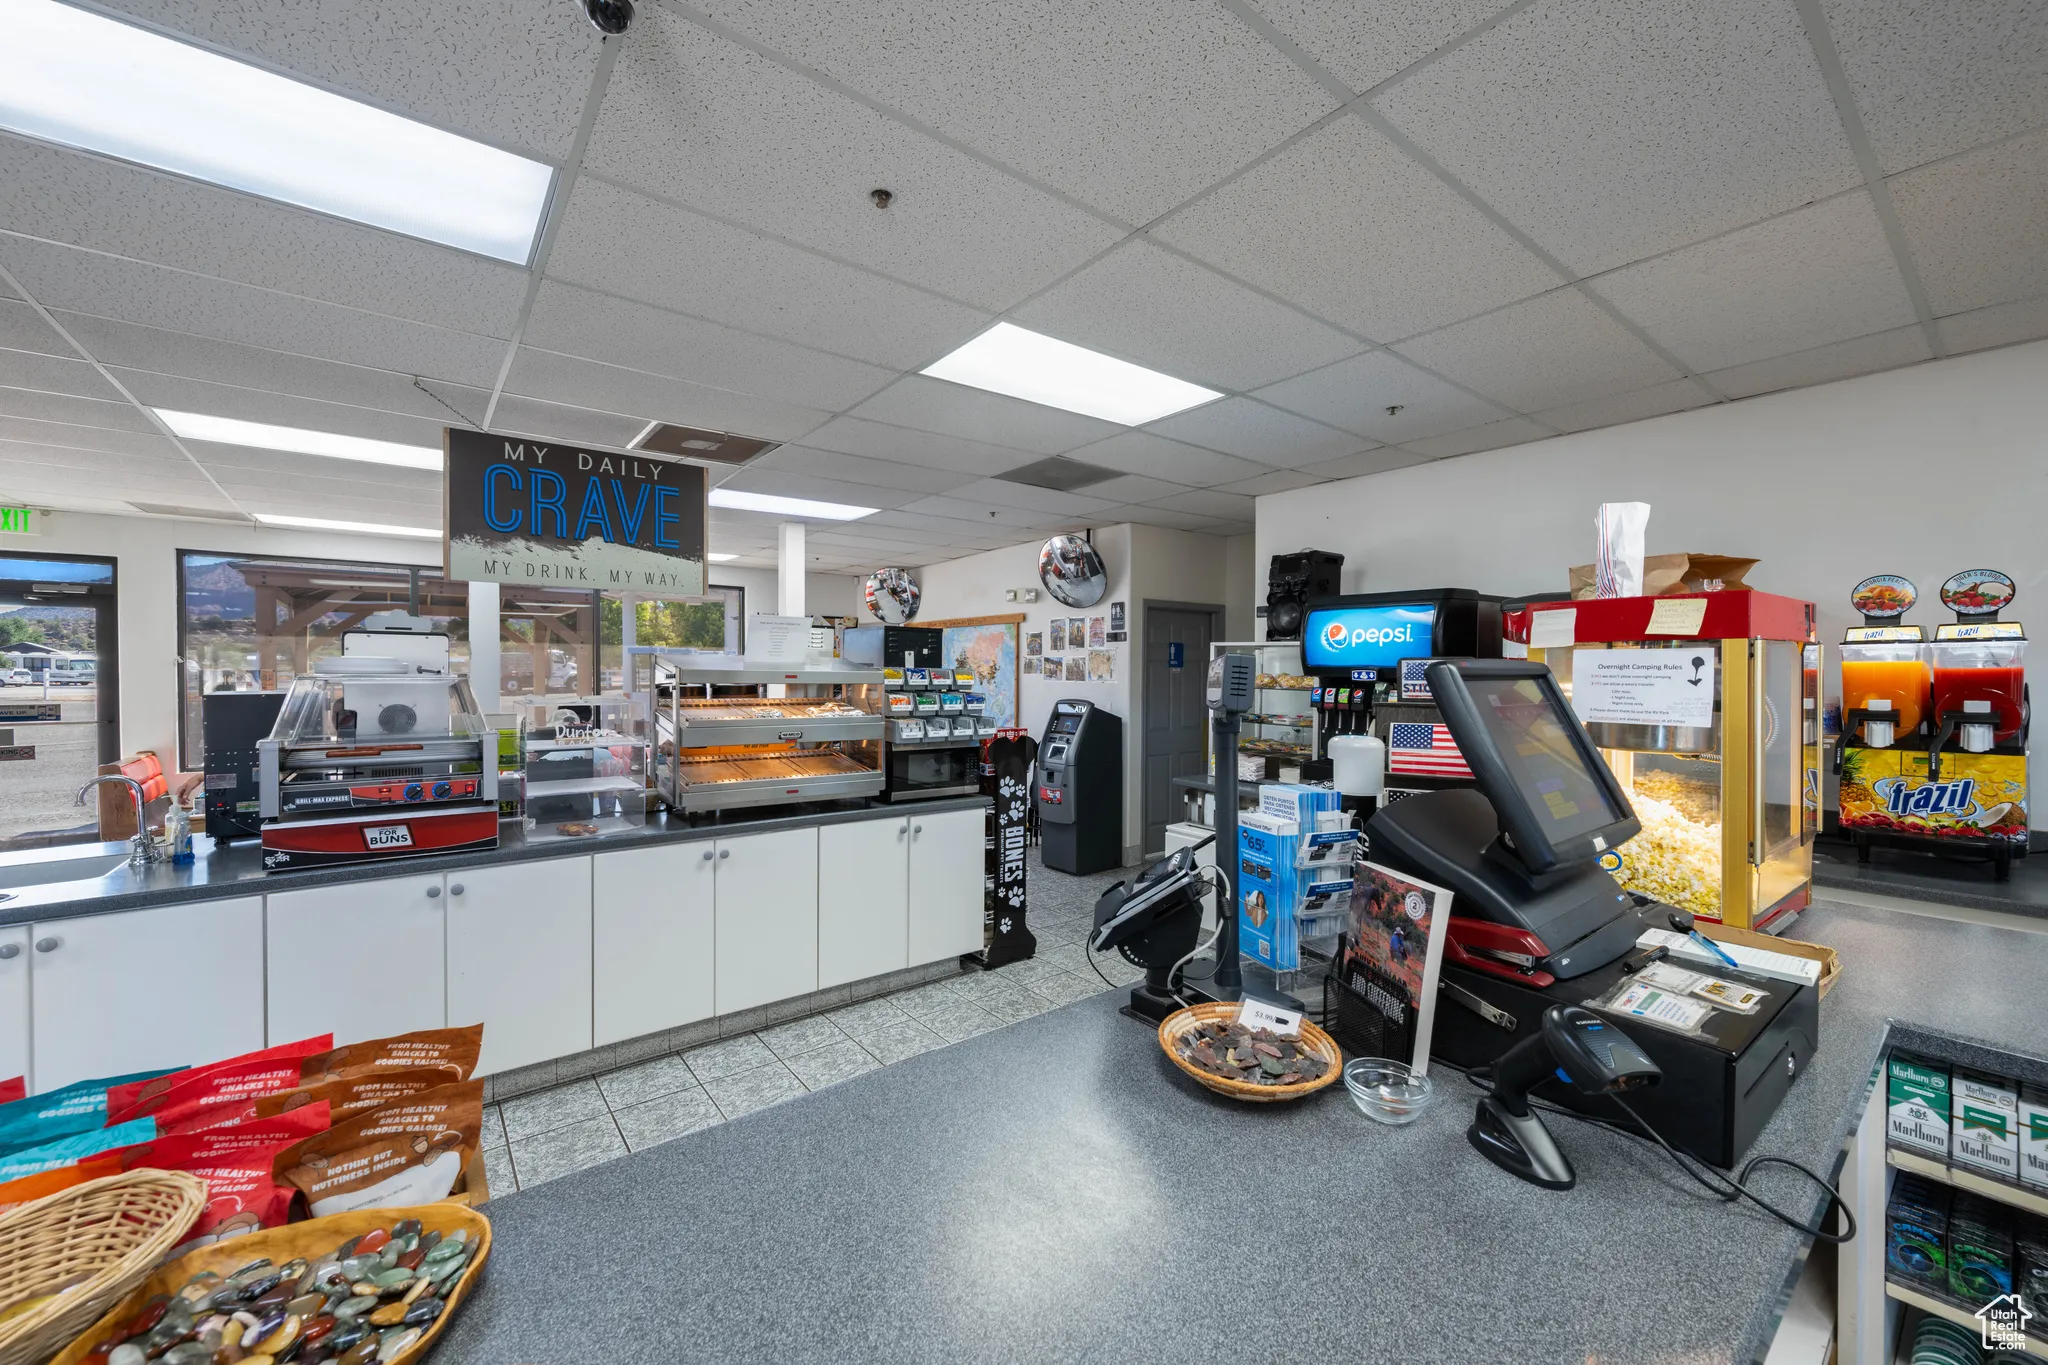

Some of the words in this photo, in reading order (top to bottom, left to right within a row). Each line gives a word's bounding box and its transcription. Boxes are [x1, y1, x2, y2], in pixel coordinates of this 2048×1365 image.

[504, 442, 548, 463] MY
[578, 453, 663, 480] DAILY
[483, 464, 680, 549] CRAVE
[0, 508, 32, 532] XIT
[484, 560, 510, 575] MY
[526, 563, 596, 581] DRINK.
[610, 569, 633, 583] MY
[645, 571, 685, 588] WAY.
[1953, 571, 1979, 583] TIGER'S
[1979, 571, 2001, 581] BLOOD
[1862, 577, 1887, 588] GEORGIA
[1887, 577, 1906, 586] PEACH
[1352, 623, 1411, 648] pepsi
[1863, 629, 1884, 639] frazil
[1957, 627, 1979, 637] frazil
[1597, 663, 1630, 671] Overnight
[325, 794, 350, 802] EXPRESS
[1887, 778, 1976, 816] frazil
[1264, 805, 1295, 816] RECOMPENSAS
[370, 834, 408, 845] BUNS
[1004, 826, 1024, 882] BONES
[412, 1042, 451, 1050] HEALTHY
[375, 1058, 412, 1066] GOODIES
[414, 1058, 449, 1066] GALORE!
[212, 1075, 243, 1086] FROM
[243, 1069, 294, 1081] HEALTHY
[1892, 1065, 1929, 1084] Marlboro
[219, 1081, 264, 1093] SNACKS
[267, 1079, 281, 1088] TO
[352, 1083, 381, 1092] FROM
[1965, 1084, 1997, 1100] Marlboro
[62, 1092, 108, 1106] SNACK
[199, 1092, 248, 1105] GOODIES
[361, 1091, 400, 1099] SNACKS
[38, 1104, 94, 1119] GOODIES
[373, 1108, 400, 1119] FROM
[401, 1105, 448, 1114] HEALTHY
[378, 1116, 419, 1125] SNACKS
[359, 1125, 403, 1136] GOODIES
[406, 1124, 448, 1132] GALORE!
[1892, 1120, 1944, 1147] Marlboro
[212, 1140, 260, 1149] SNACKS
[1960, 1140, 2010, 1167] Marlboro
[327, 1156, 371, 1177] NOTHIN'
[373, 1150, 393, 1163] BUT
[214, 1168, 266, 1178] HEALTHY
[311, 1168, 371, 1193] NUTTINESS
[372, 1156, 407, 1172] INSIDE
[211, 1183, 258, 1193] GALORE!
[1893, 1222, 1941, 1246] CAMEL
[1954, 1243, 2005, 1268] CAMEL
